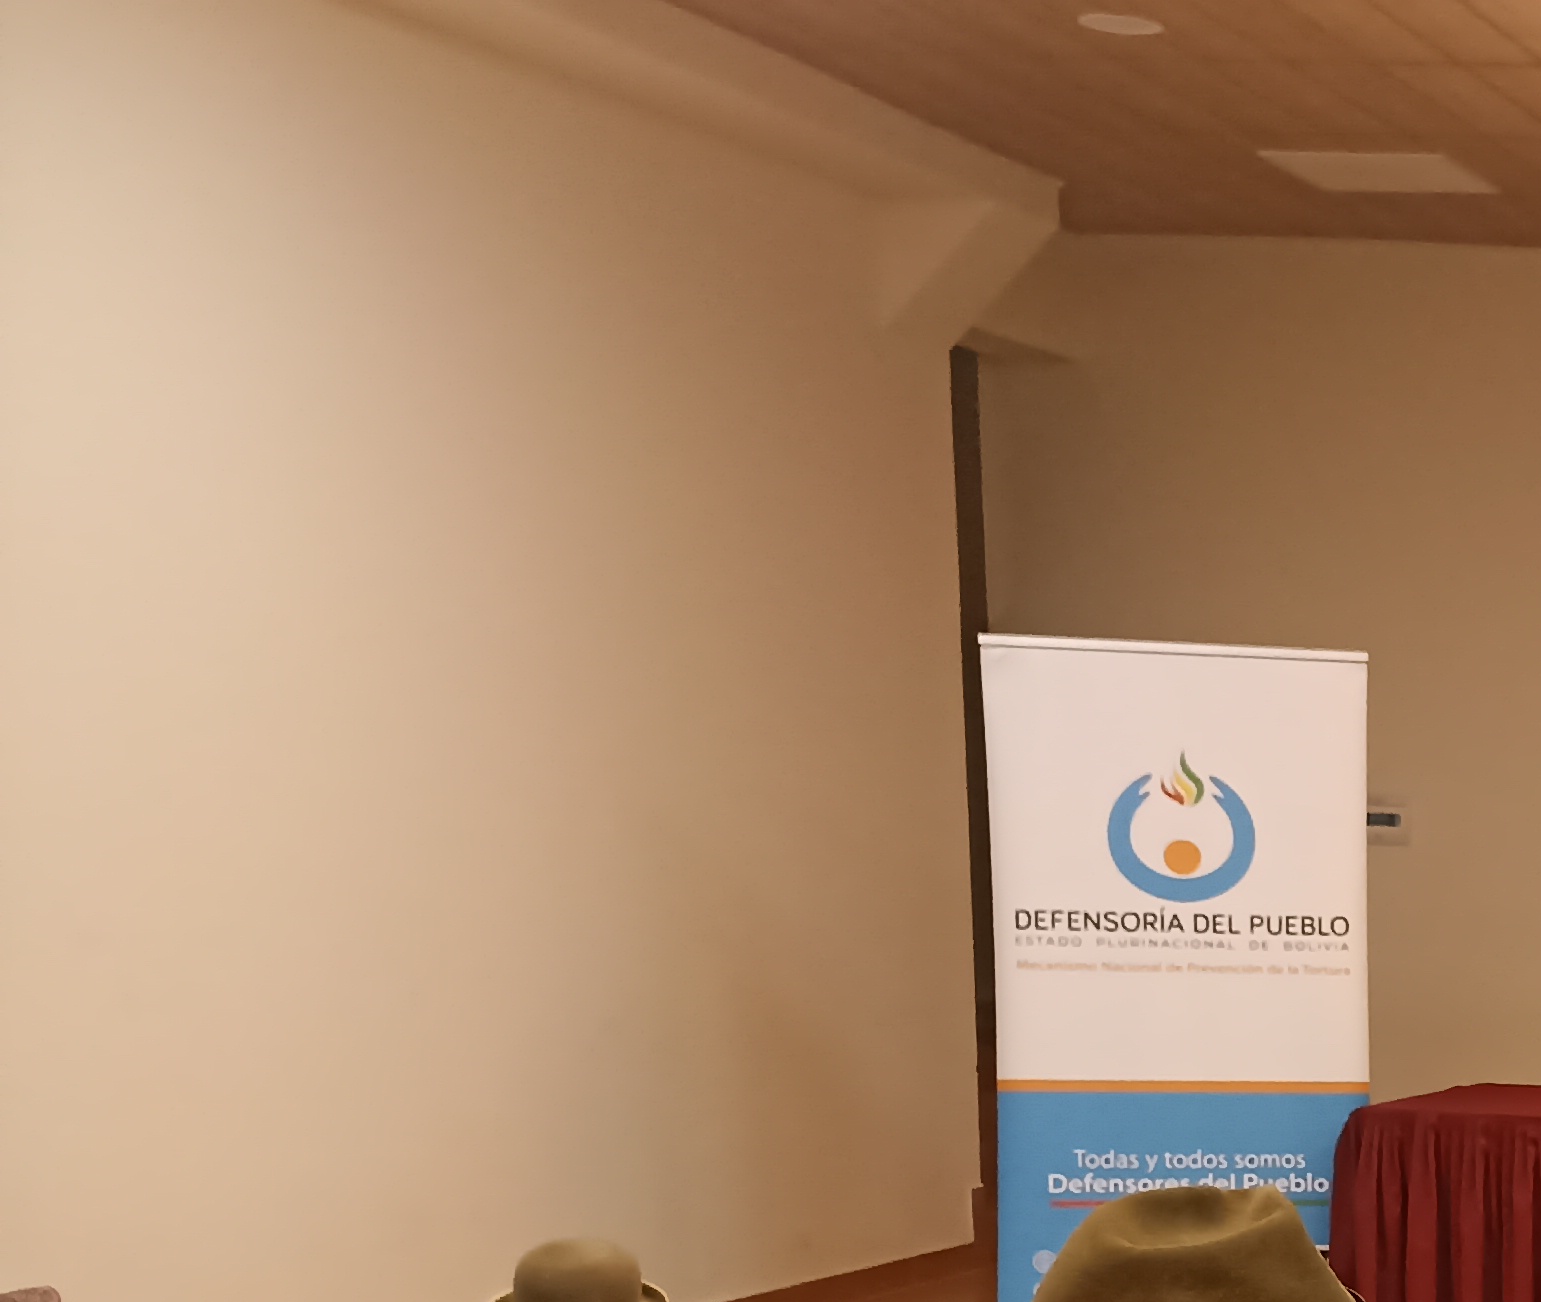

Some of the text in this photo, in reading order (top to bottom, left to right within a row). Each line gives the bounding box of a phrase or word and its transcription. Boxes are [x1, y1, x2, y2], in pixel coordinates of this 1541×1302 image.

[1015, 905, 1350, 937] DEFENSORÍA DEL PUEBLO
[1015, 935, 1349, 953] ESTADO PLURINACIONAL DE BOLIVIA
[1073, 1148, 1306, 1174] Todas y todos somos
